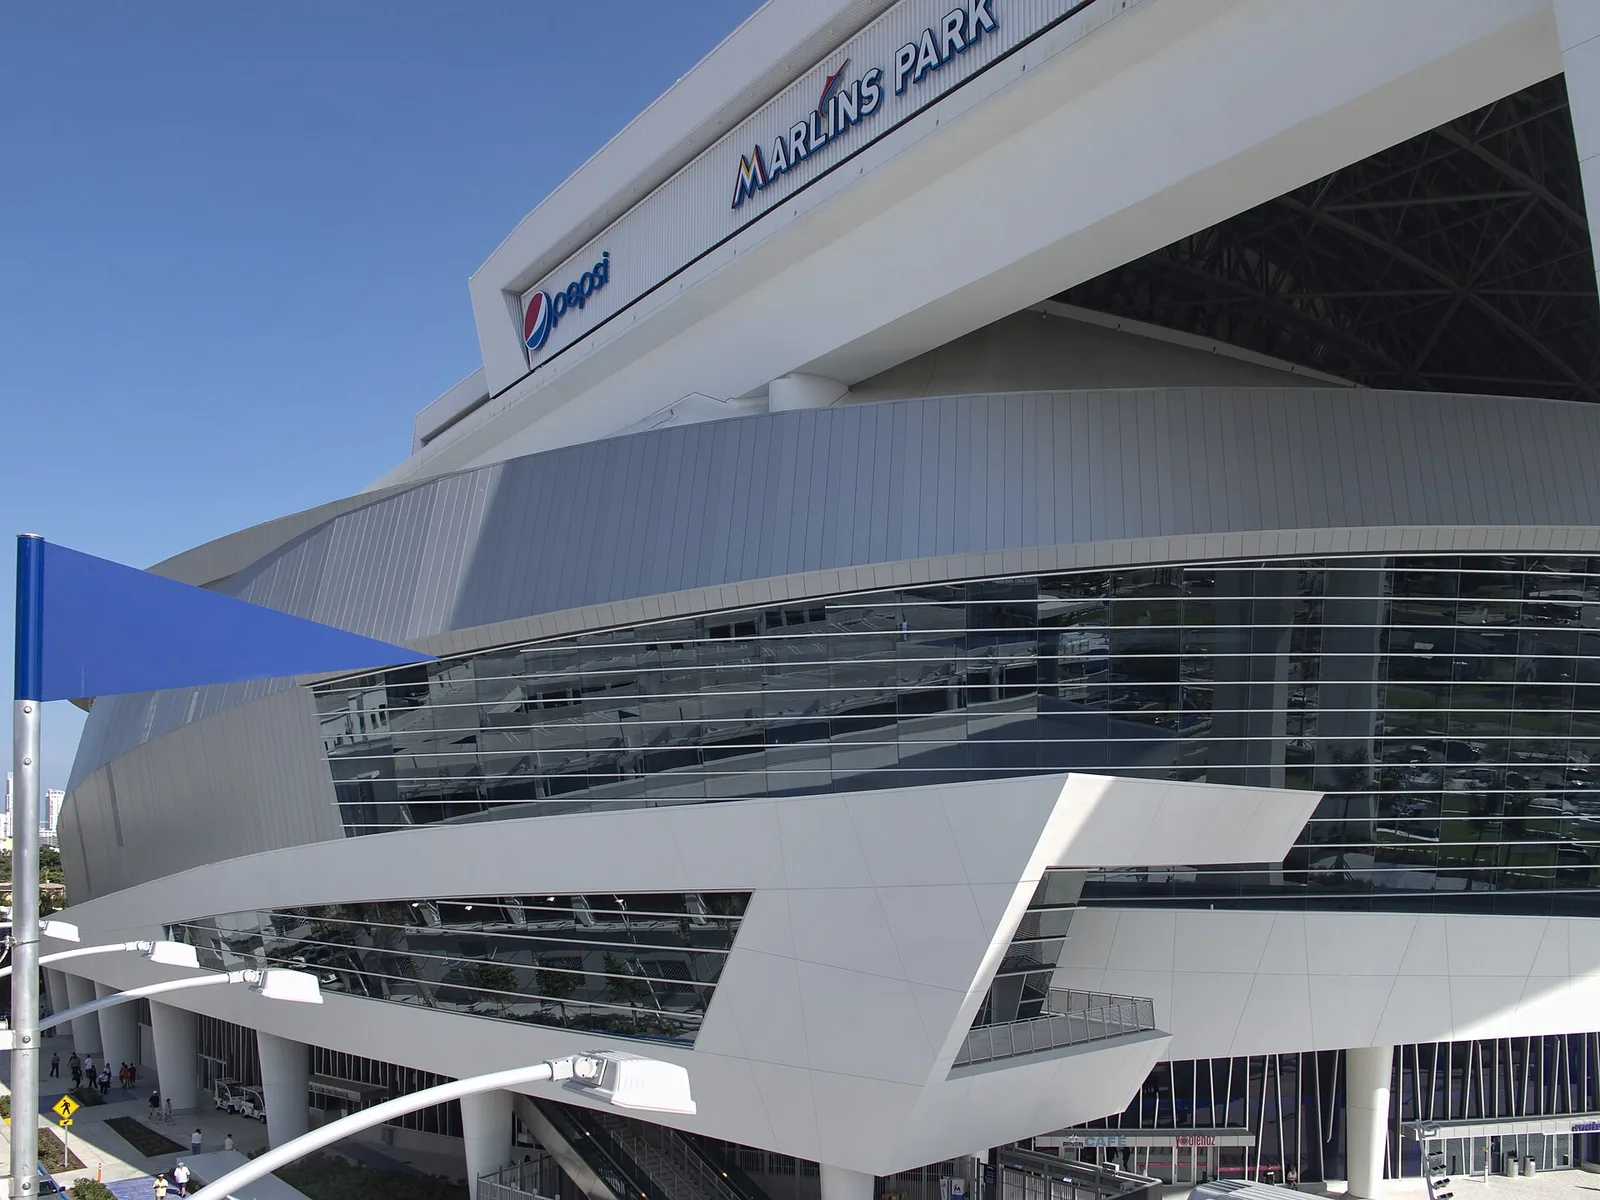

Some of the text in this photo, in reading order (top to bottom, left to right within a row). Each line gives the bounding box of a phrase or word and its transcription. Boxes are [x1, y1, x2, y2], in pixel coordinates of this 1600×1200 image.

[731, 0, 999, 209] MARLINS PARK
[551, 250, 611, 329] pepsi
[1084, 1135, 1127, 1147] CAFÉ
